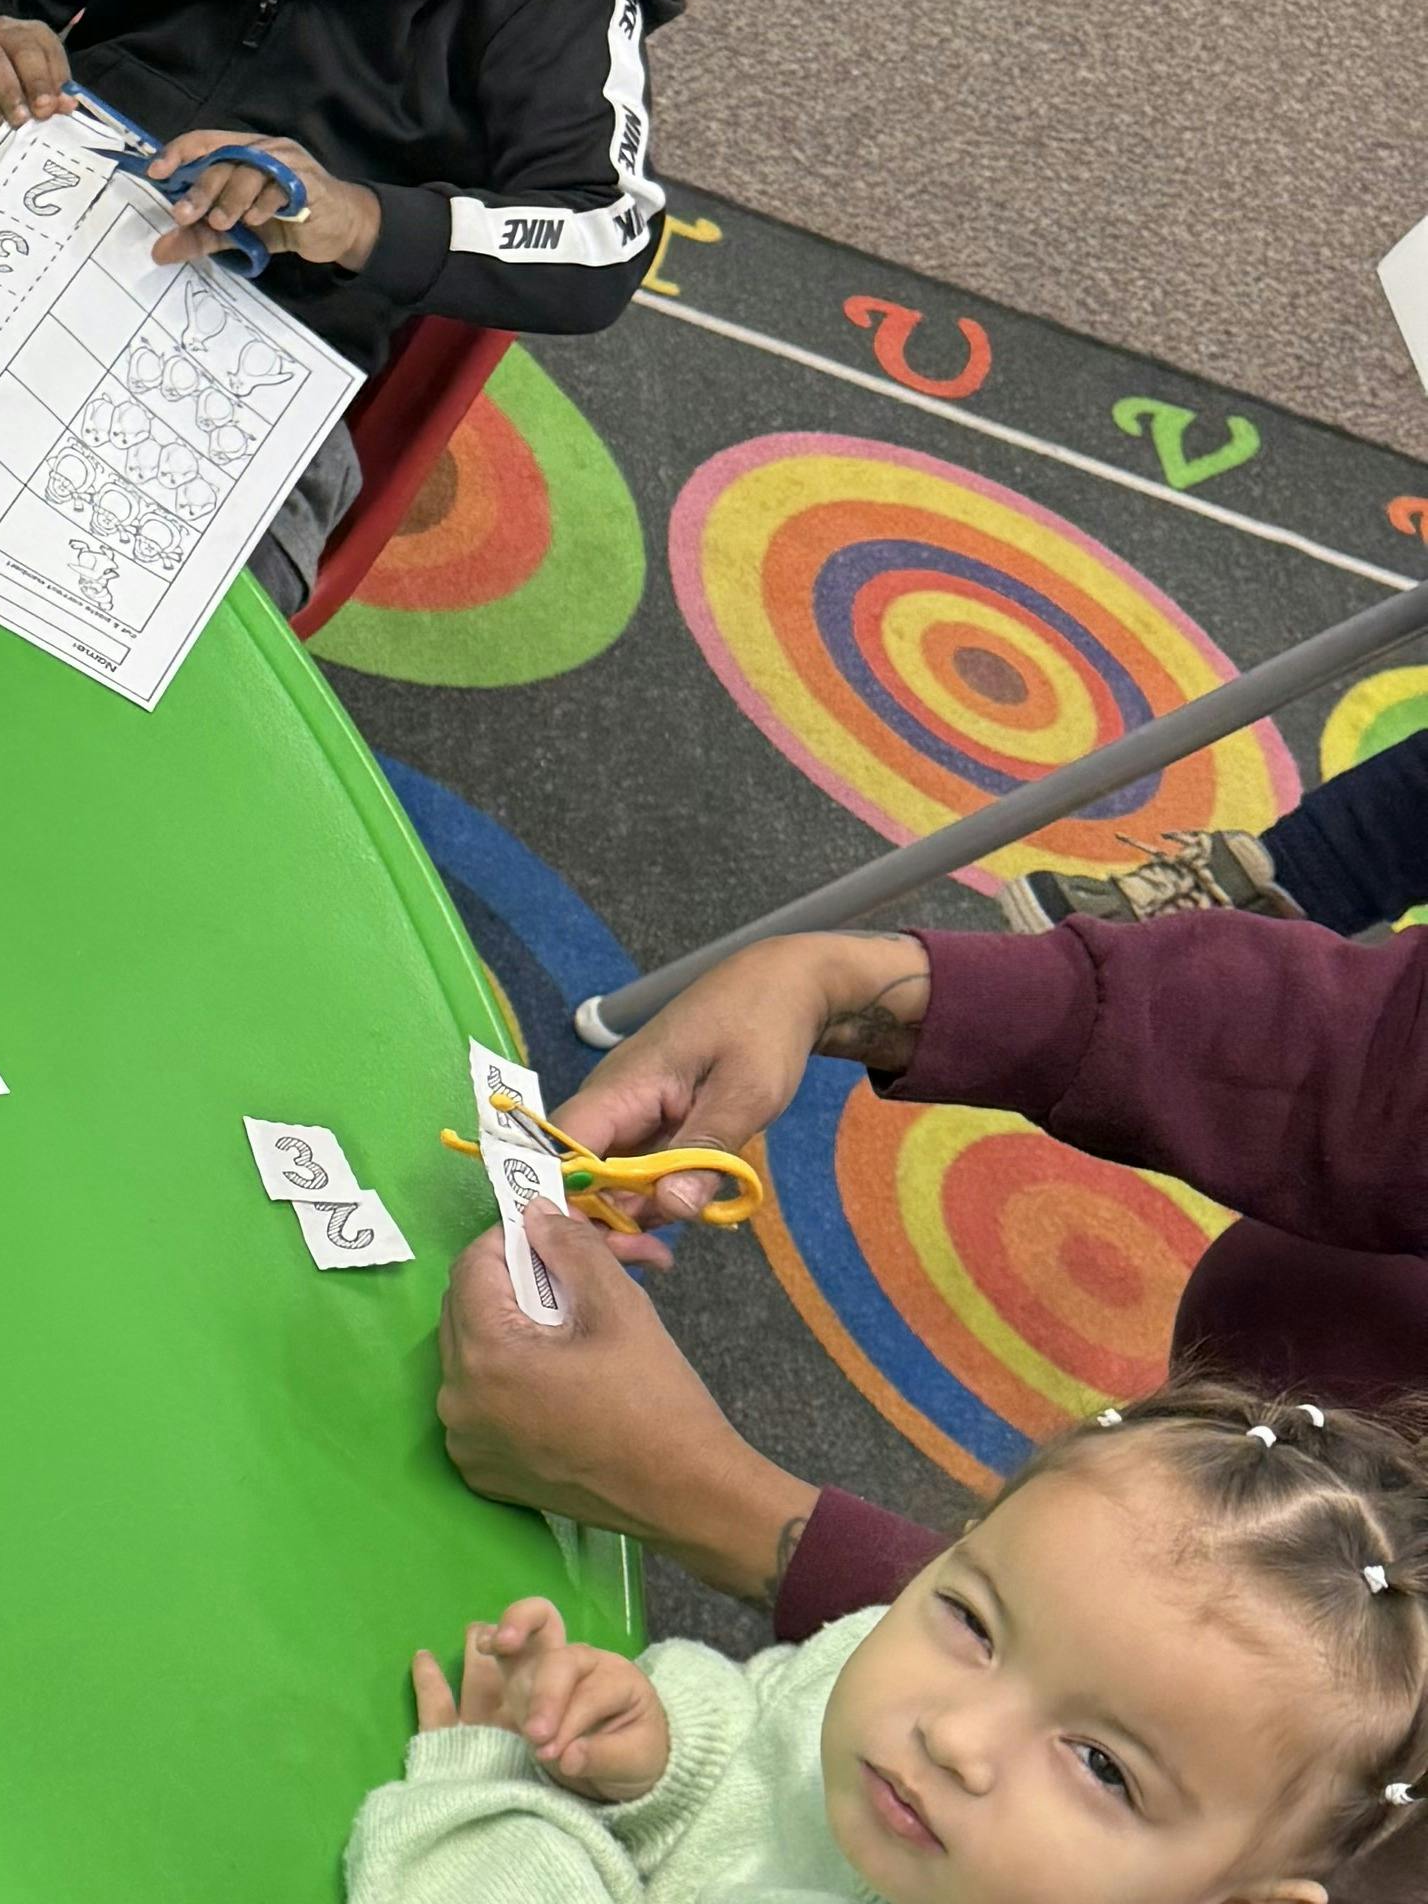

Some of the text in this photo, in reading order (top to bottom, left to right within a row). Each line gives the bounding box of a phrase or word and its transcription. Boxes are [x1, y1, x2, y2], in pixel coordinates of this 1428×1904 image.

[617, 104, 644, 176] NIKE
[22, 159, 81, 217] 2
[499, 218, 565, 251] NIKE
[72, 642, 118, 673] Name:
[275, 1136, 329, 1190] 3
[313, 1201, 375, 1250] 2
